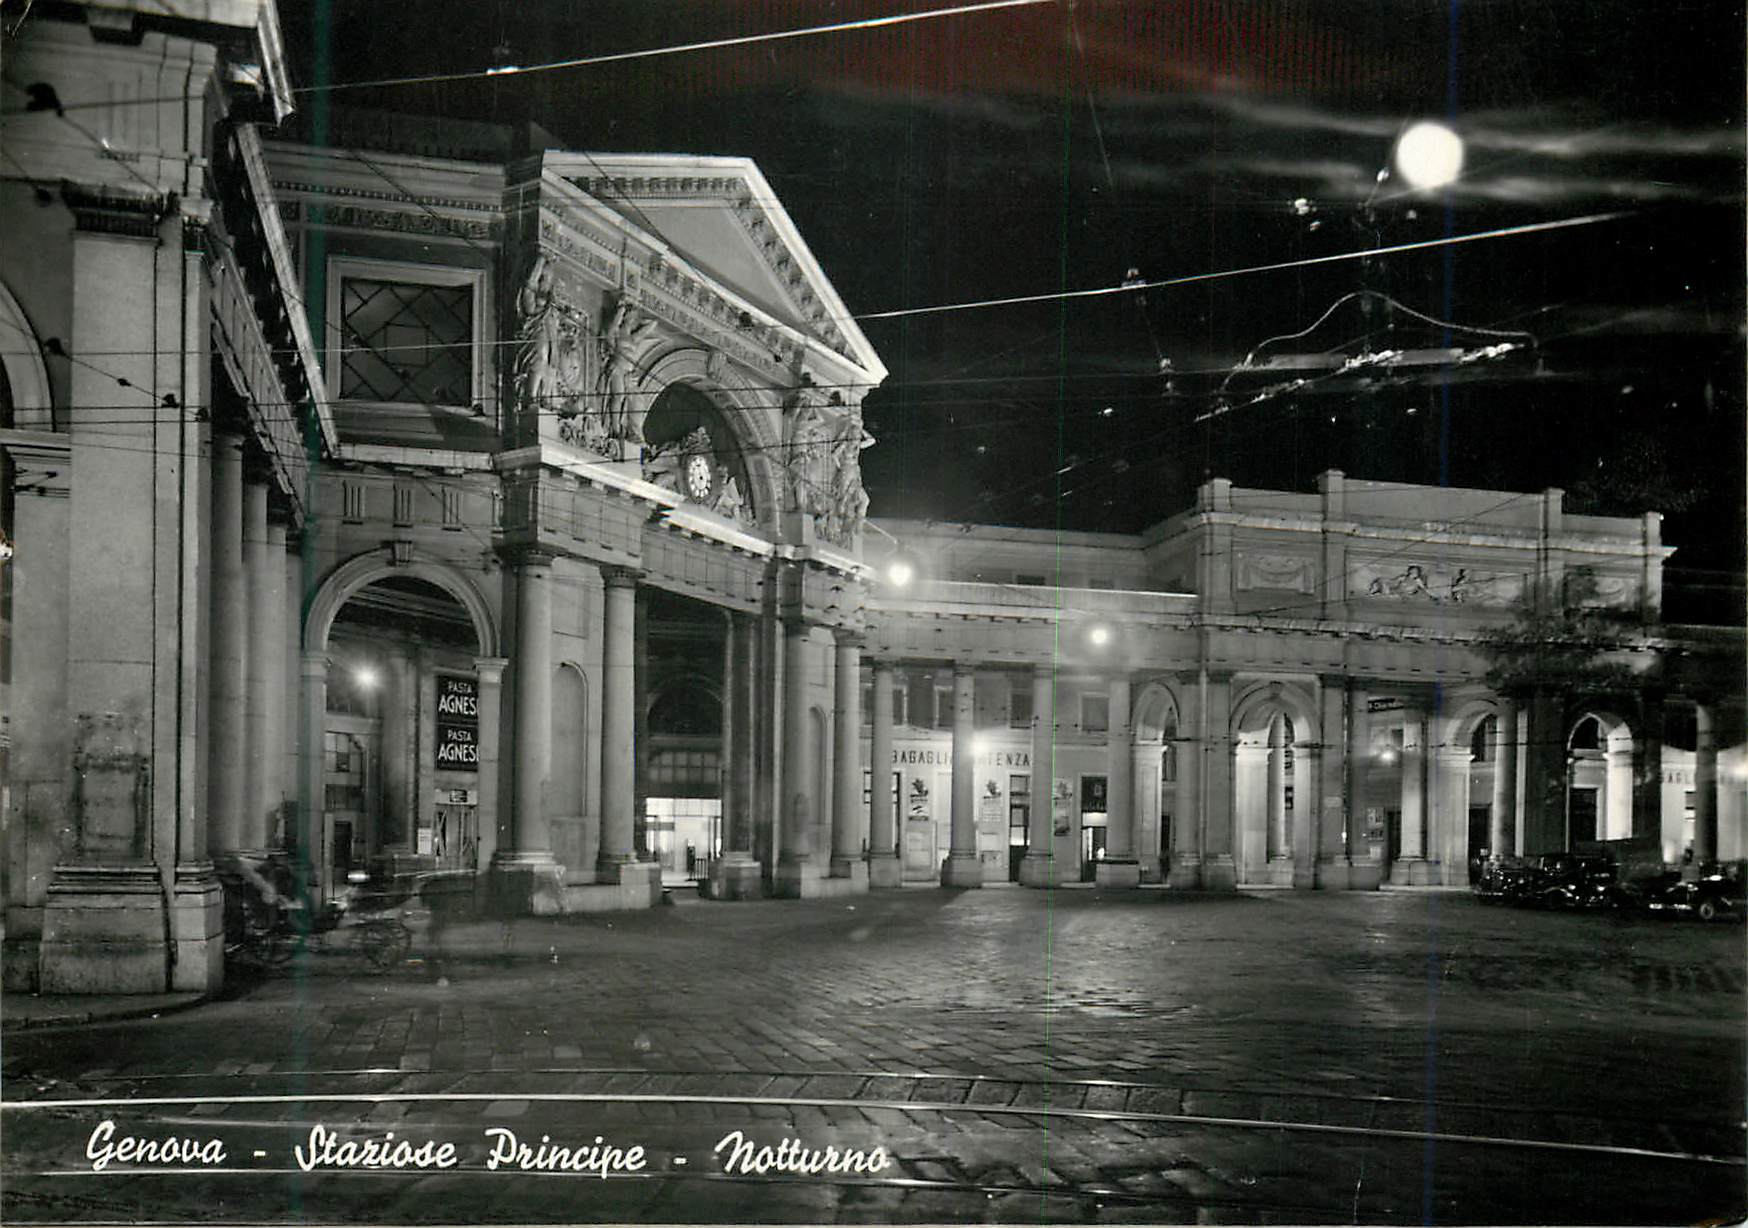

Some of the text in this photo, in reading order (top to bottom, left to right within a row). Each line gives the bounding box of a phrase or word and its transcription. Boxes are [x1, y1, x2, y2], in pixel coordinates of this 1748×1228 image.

[448, 681, 472, 693] PASTA
[447, 729, 471, 741] PASTA
[979, 751, 1030, 767] TENZA
